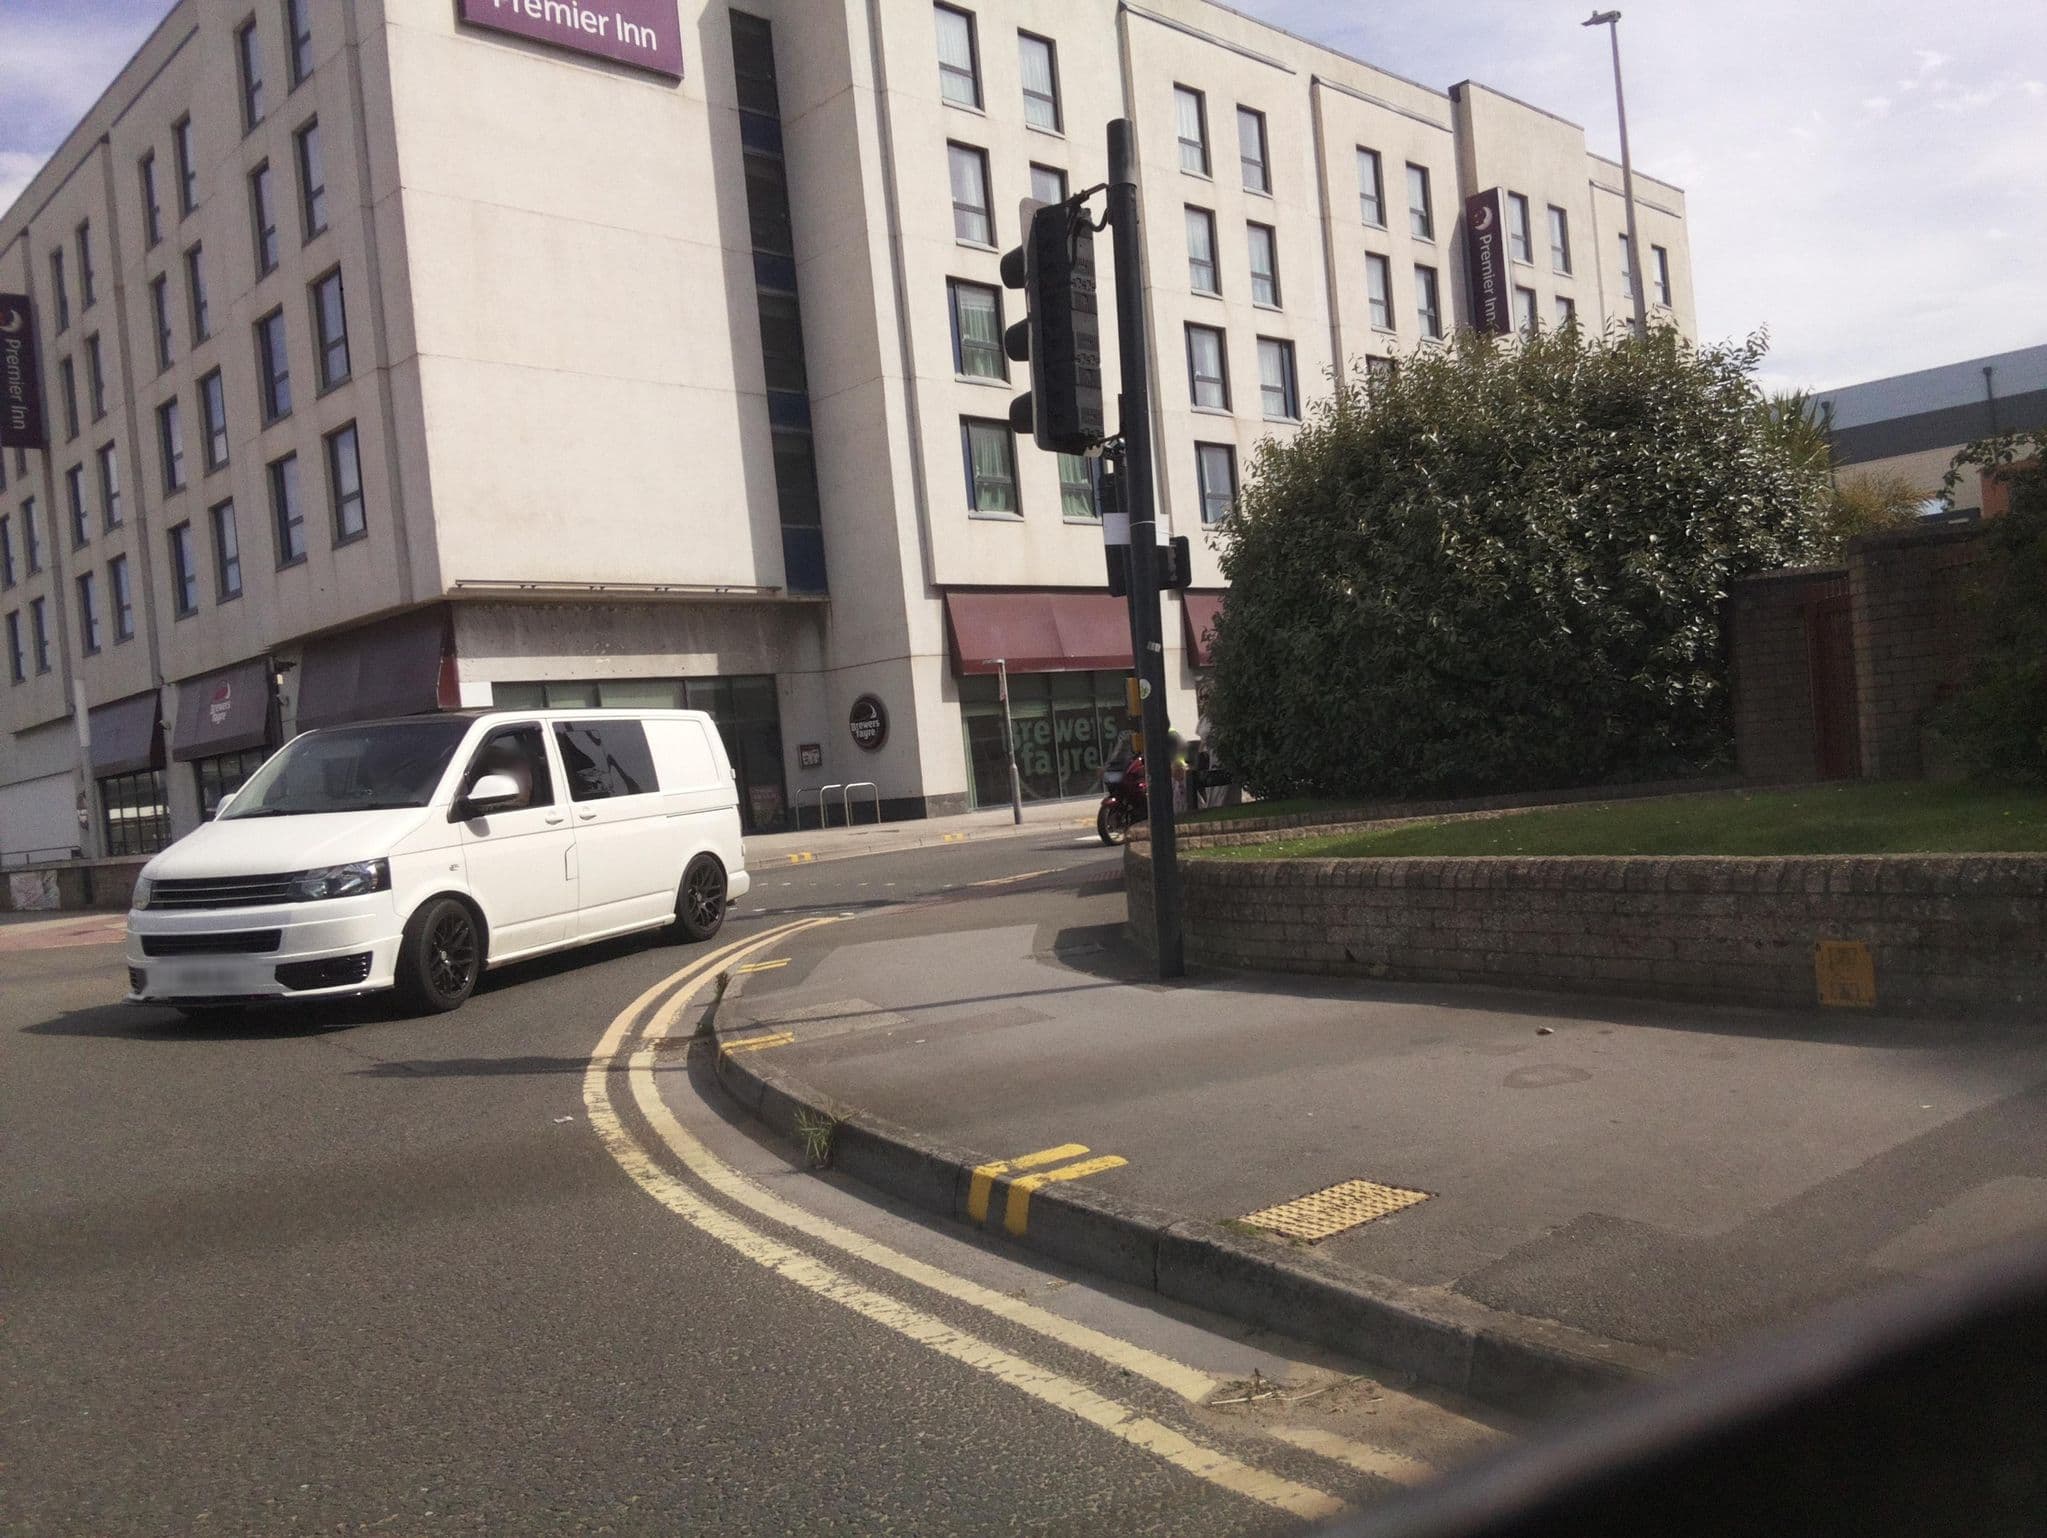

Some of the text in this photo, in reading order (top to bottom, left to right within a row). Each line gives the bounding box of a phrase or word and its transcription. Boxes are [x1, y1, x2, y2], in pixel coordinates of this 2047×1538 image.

[494, 0, 658, 52] remier Inn
[1479, 233, 1498, 323] Premier Inn
[5, 338, 29, 431] Premier Inn
[850, 718, 881, 732] Brewers
